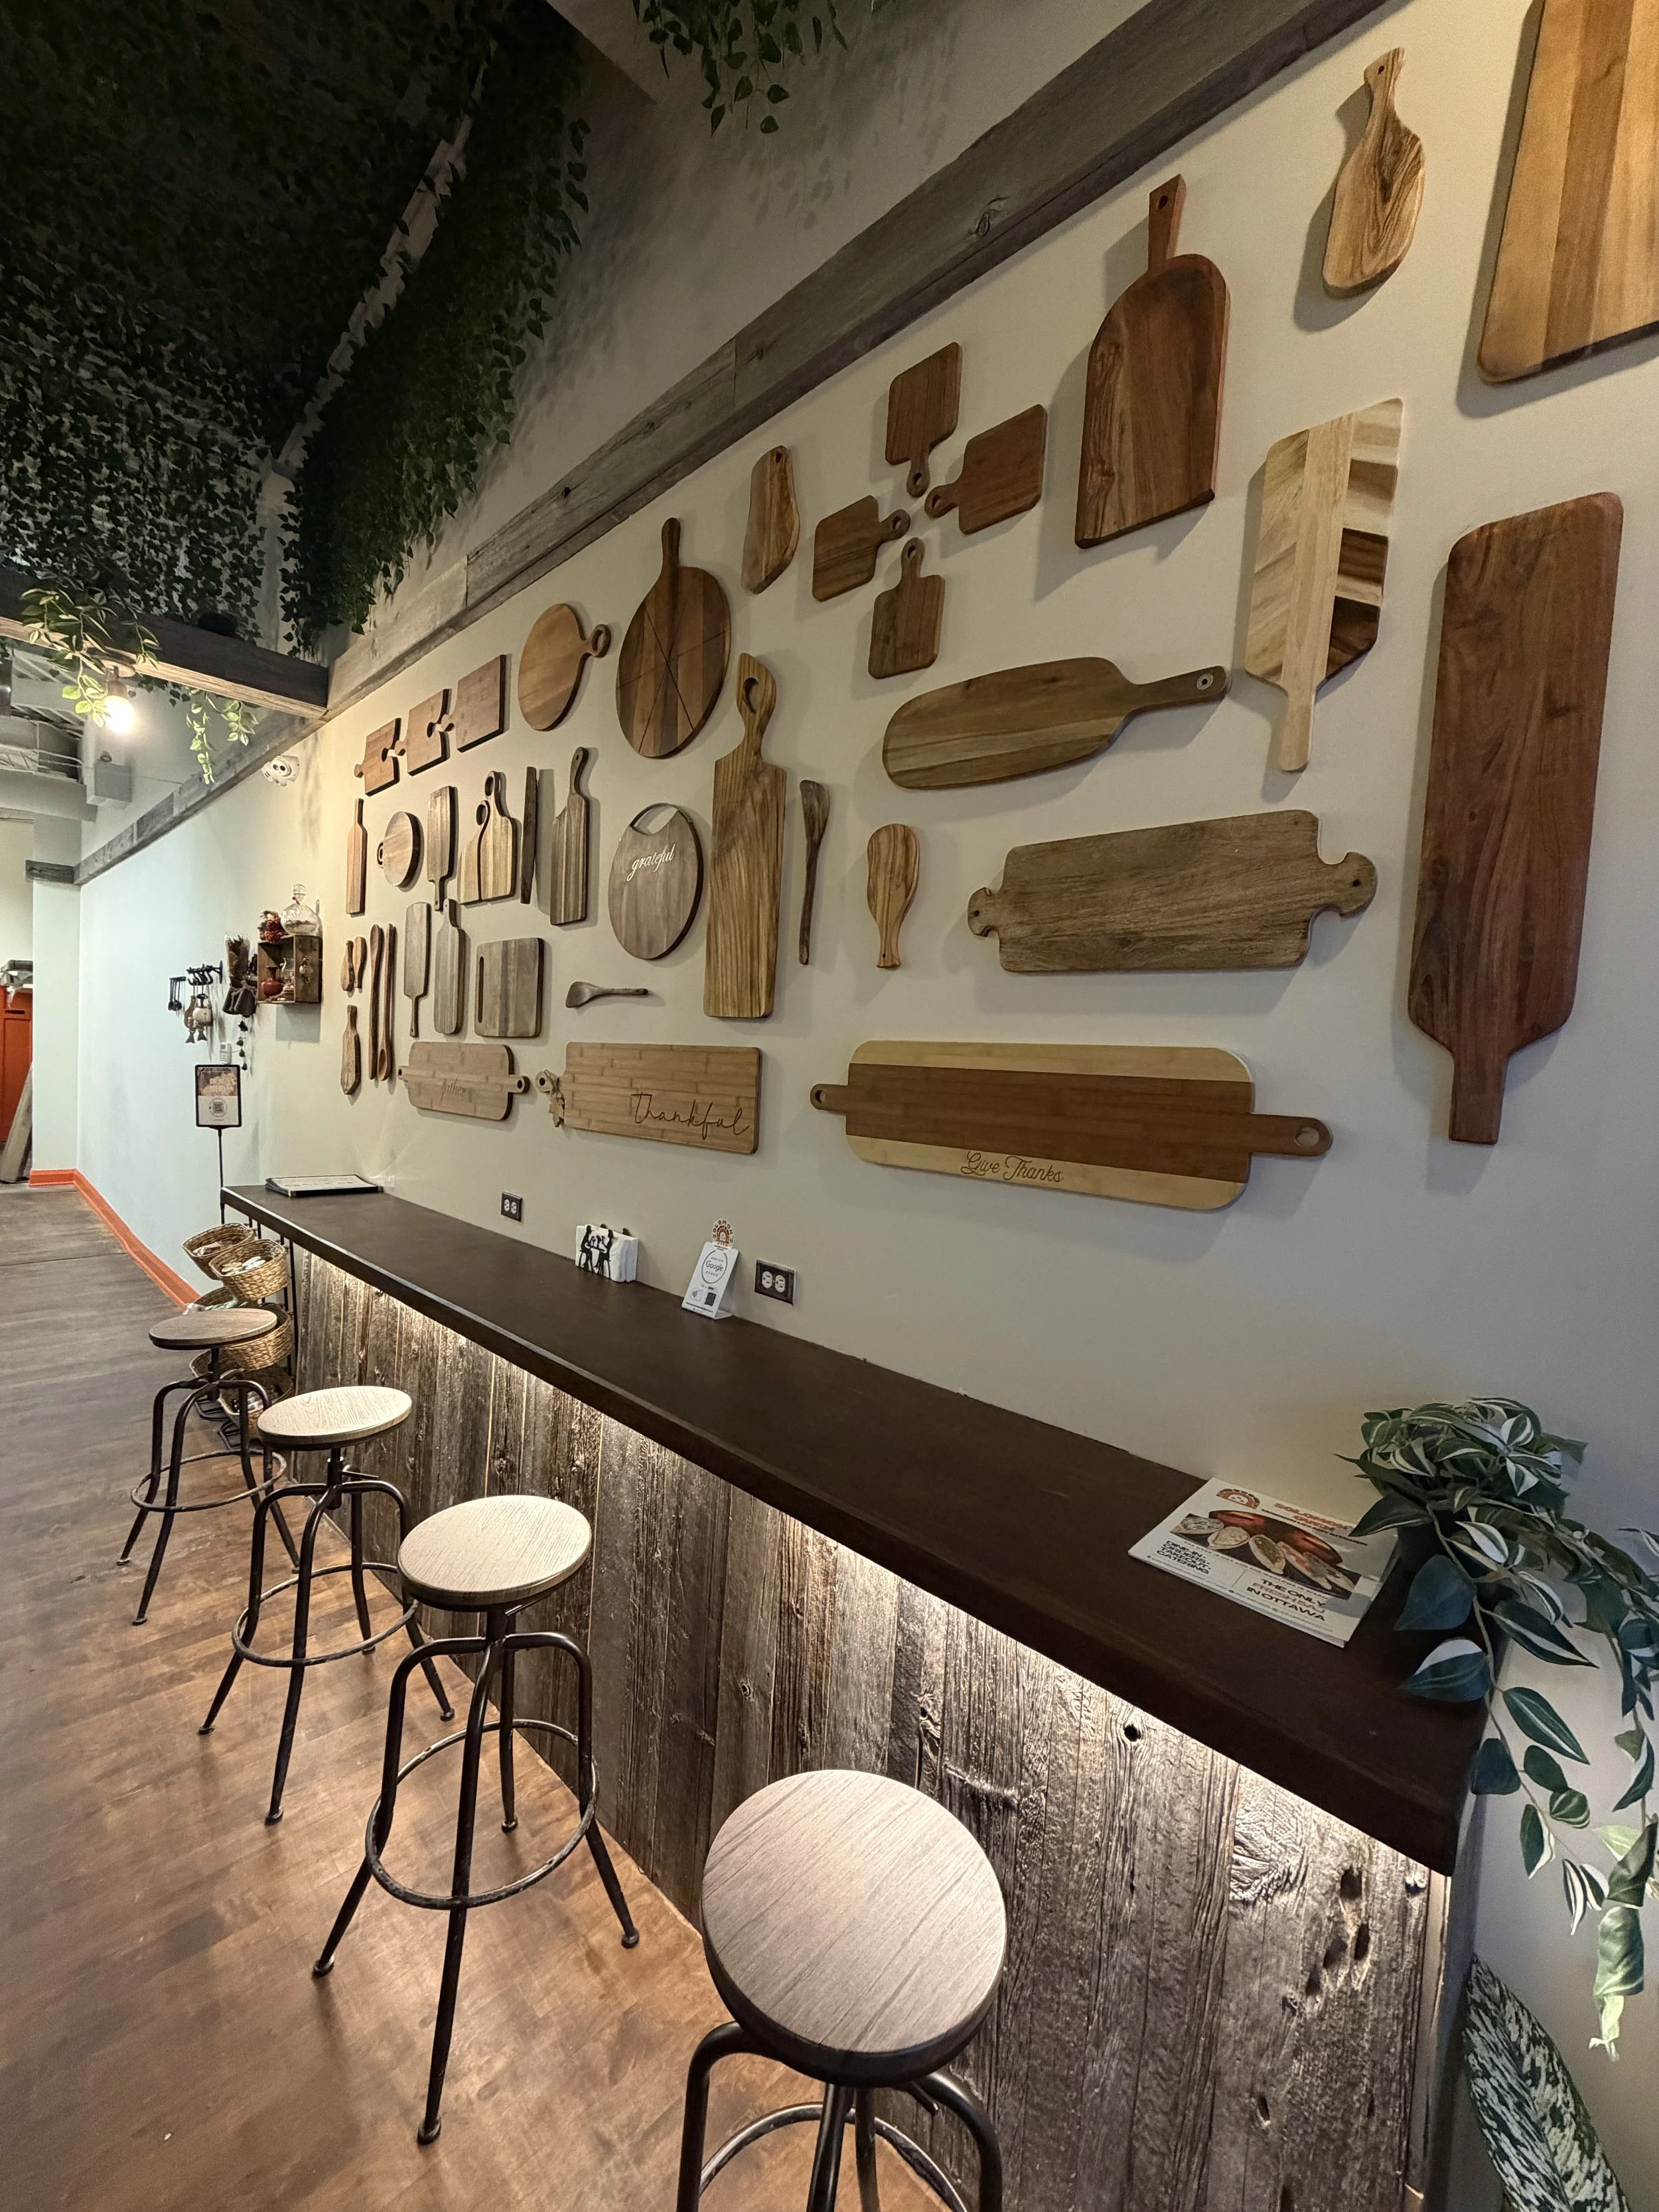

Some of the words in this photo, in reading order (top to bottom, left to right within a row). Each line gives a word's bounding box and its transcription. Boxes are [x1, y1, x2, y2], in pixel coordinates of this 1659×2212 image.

[626, 843, 676, 881] grateful
[961, 1151, 1001, 1176] Give
[1003, 1155, 1064, 1183] Thanks
[705, 1260, 724, 1272] Google
[1157, 1550, 1209, 1574] CATERING
[1161, 1546, 1208, 1568] TAKEOUT
[1166, 1540, 1202, 1558] DINE-IN
[1246, 1586, 1261, 1595] IN
[1262, 1593, 1325, 1621] OTTAWA
[1261, 1578, 1287, 1592] THE
[1287, 1589, 1326, 1606] ONLY
